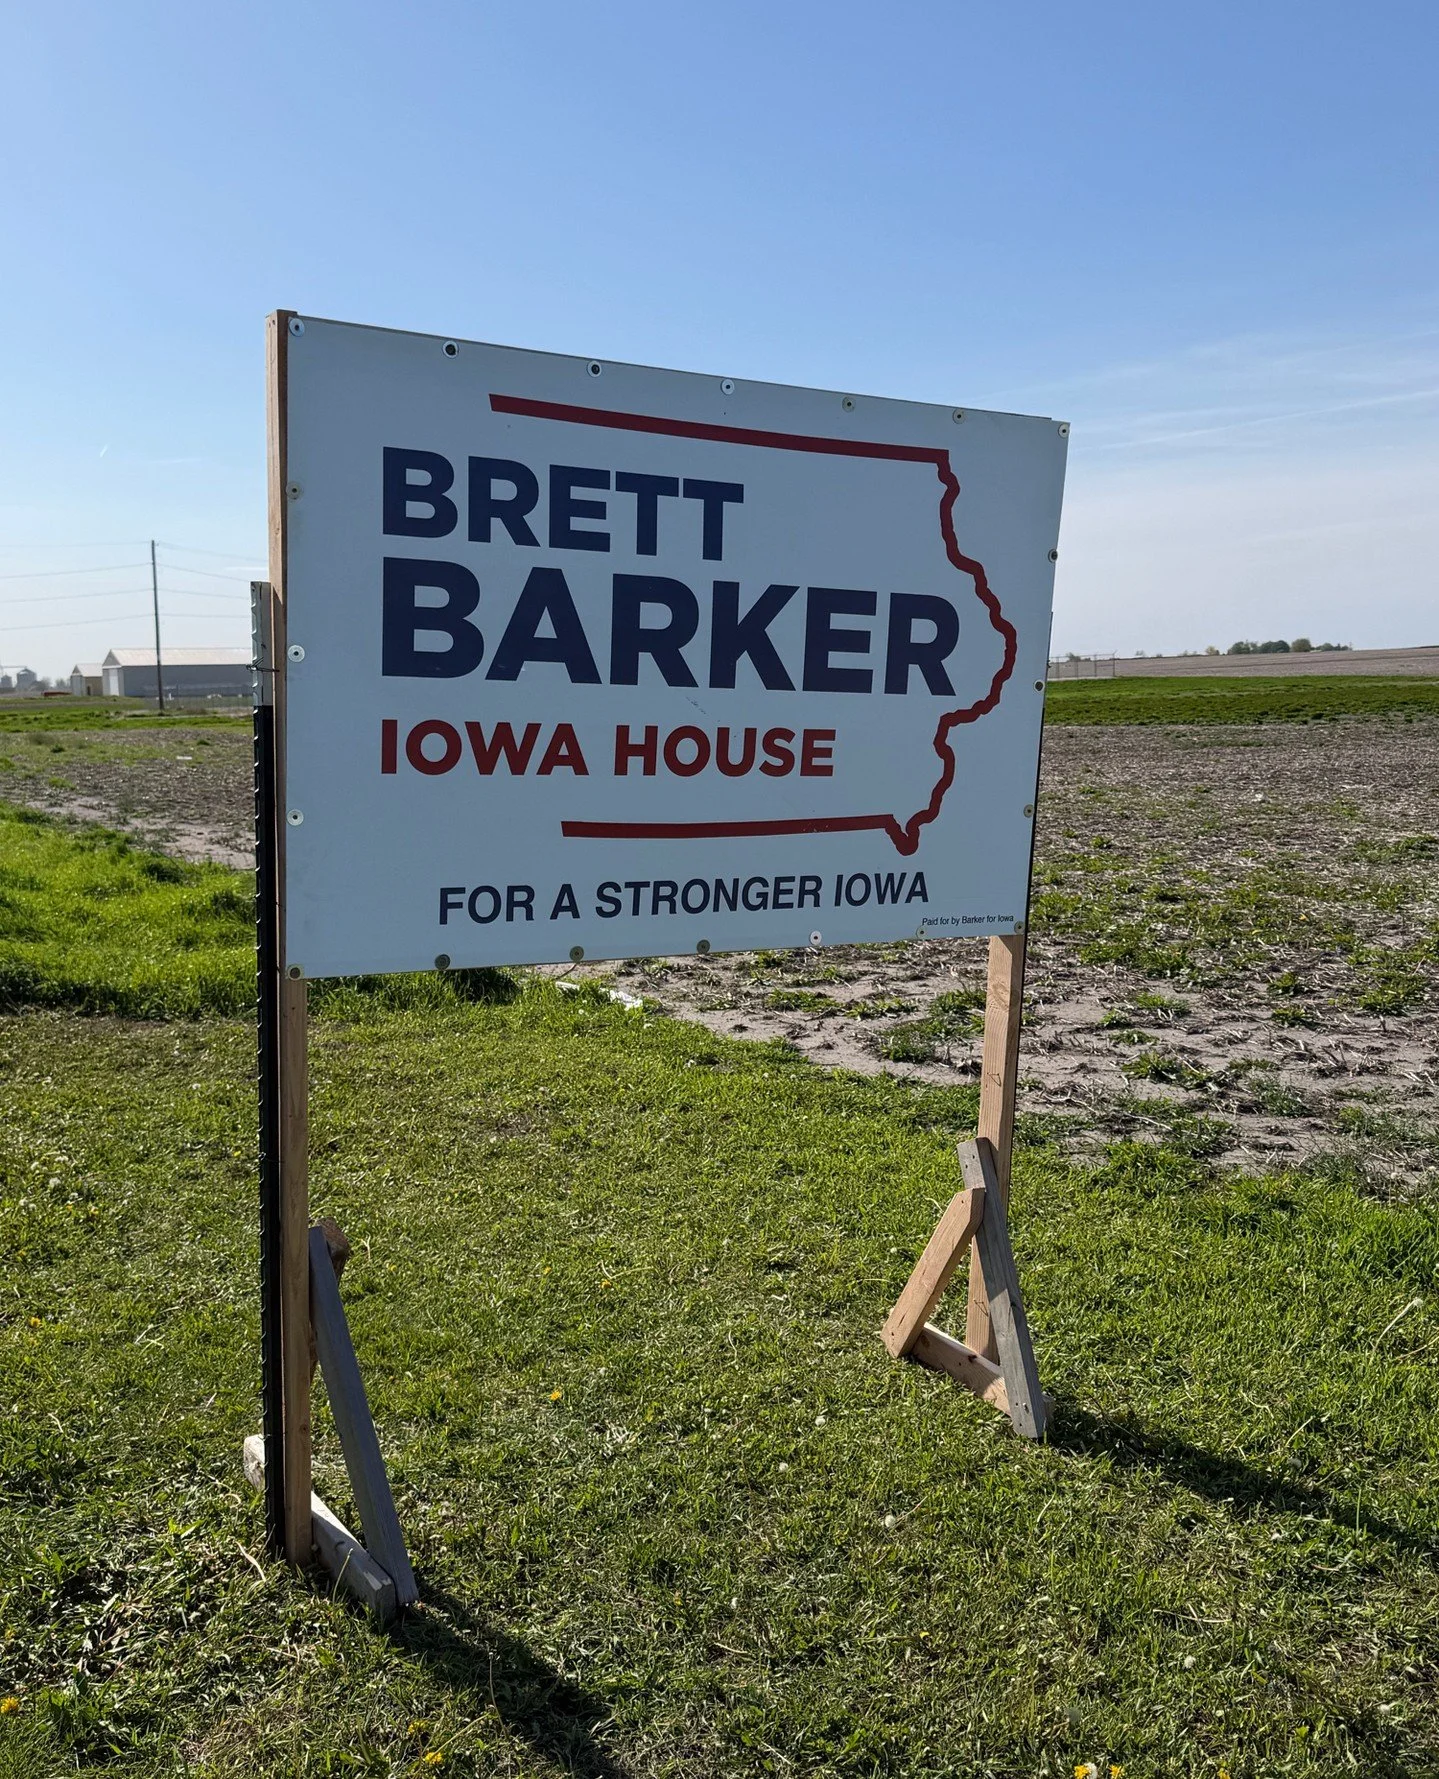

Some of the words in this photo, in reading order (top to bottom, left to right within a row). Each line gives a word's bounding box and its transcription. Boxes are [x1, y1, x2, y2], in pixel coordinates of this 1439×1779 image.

[382, 446, 744, 562] BRETT
[382, 556, 960, 697] BARKER
[381, 718, 589, 777] IOWA
[614, 724, 836, 778] HOUSE
[439, 885, 535, 925] FOR
[549, 883, 582, 921] A
[595, 875, 822, 919] STRONGER
[833, 872, 929, 907] IOWA
[922, 917, 938, 926] Paid
[940, 917, 949, 925] for
[951, 917, 960, 926] by
[962, 915, 985, 924] Barker
[987, 915, 996, 923] for
[998, 914, 1014, 922] Iowa
